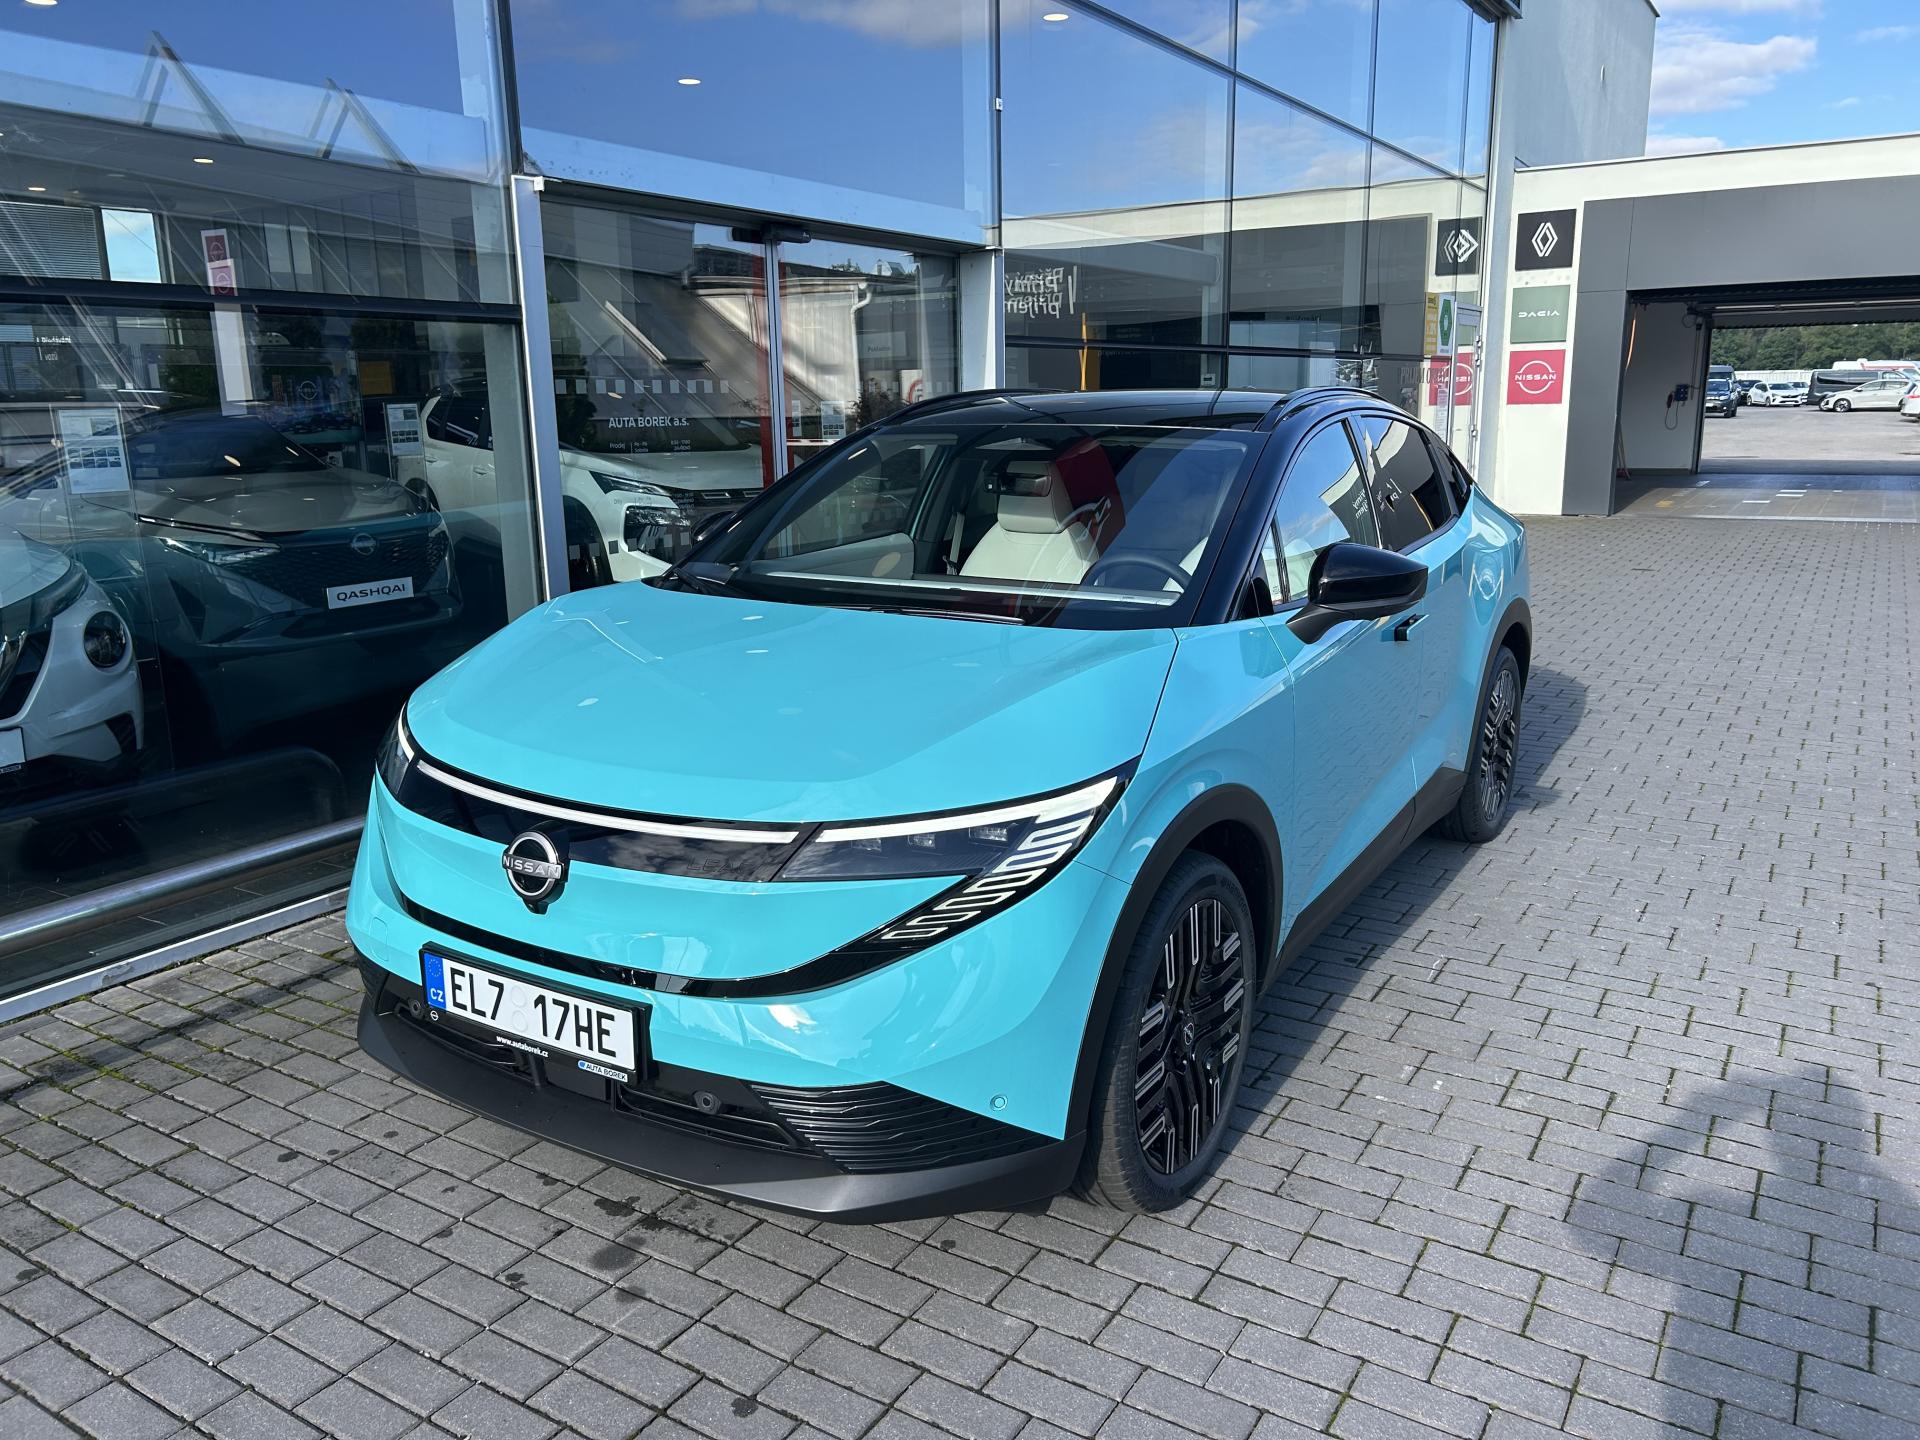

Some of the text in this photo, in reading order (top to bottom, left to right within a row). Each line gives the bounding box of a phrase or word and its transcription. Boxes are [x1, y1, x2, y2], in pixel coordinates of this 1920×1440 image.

[1518, 310, 1560, 318] DACIA
[1514, 373, 1557, 381] NISSAN
[608, 416, 690, 429] AUTA BOREK a.s.
[336, 583, 406, 602] QASHQAI
[502, 855, 560, 879] NISSAN
[429, 987, 445, 1003] CZ
[450, 966, 617, 1058] EL7 17HE
[496, 1035, 549, 1058] www.autaborek.cz
[585, 1062, 627, 1081] AUTA BOREK
